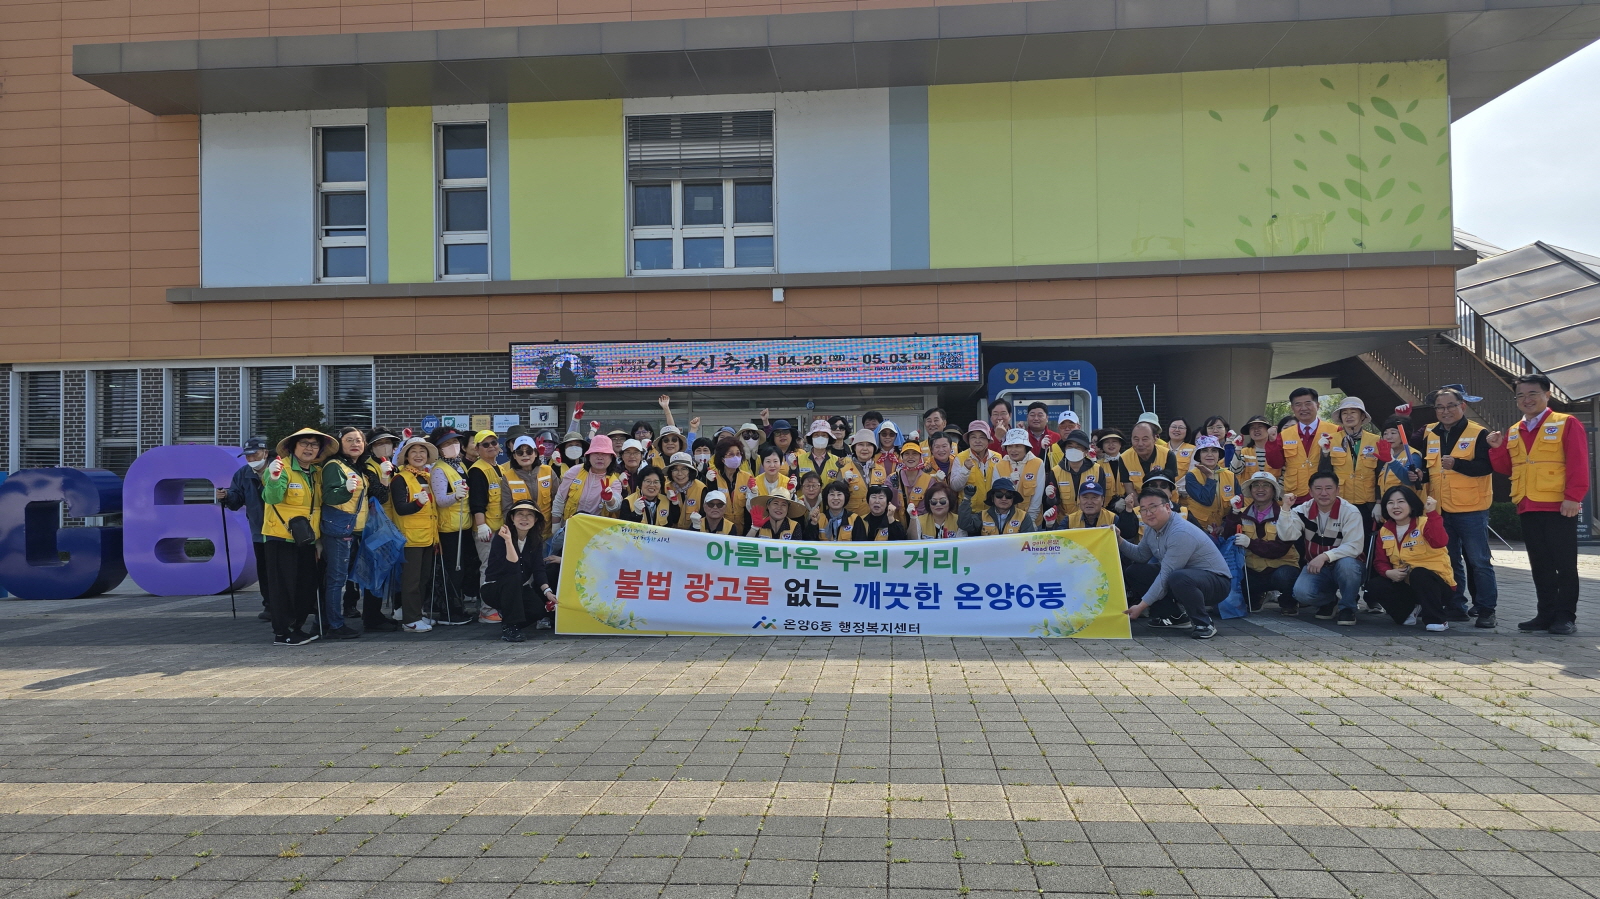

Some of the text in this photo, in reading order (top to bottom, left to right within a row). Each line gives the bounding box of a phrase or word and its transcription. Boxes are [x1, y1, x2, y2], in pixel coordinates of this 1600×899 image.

[646, 352, 769, 374] 이순신축제
[777, 355, 800, 366] 04.
[803, 354, 827, 366] 28.
[862, 353, 885, 365] 05.
[889, 353, 911, 364] 03.
[1023, 369, 1081, 381] 온양농협
[424, 421, 438, 429] ADT
[706, 541, 971, 576] 아름다운 우리 거리,
[614, 568, 1067, 610] 불법 광고물 없는 깨끗한 온양6동
[783, 619, 921, 634] 온양6동 행정복지센터
